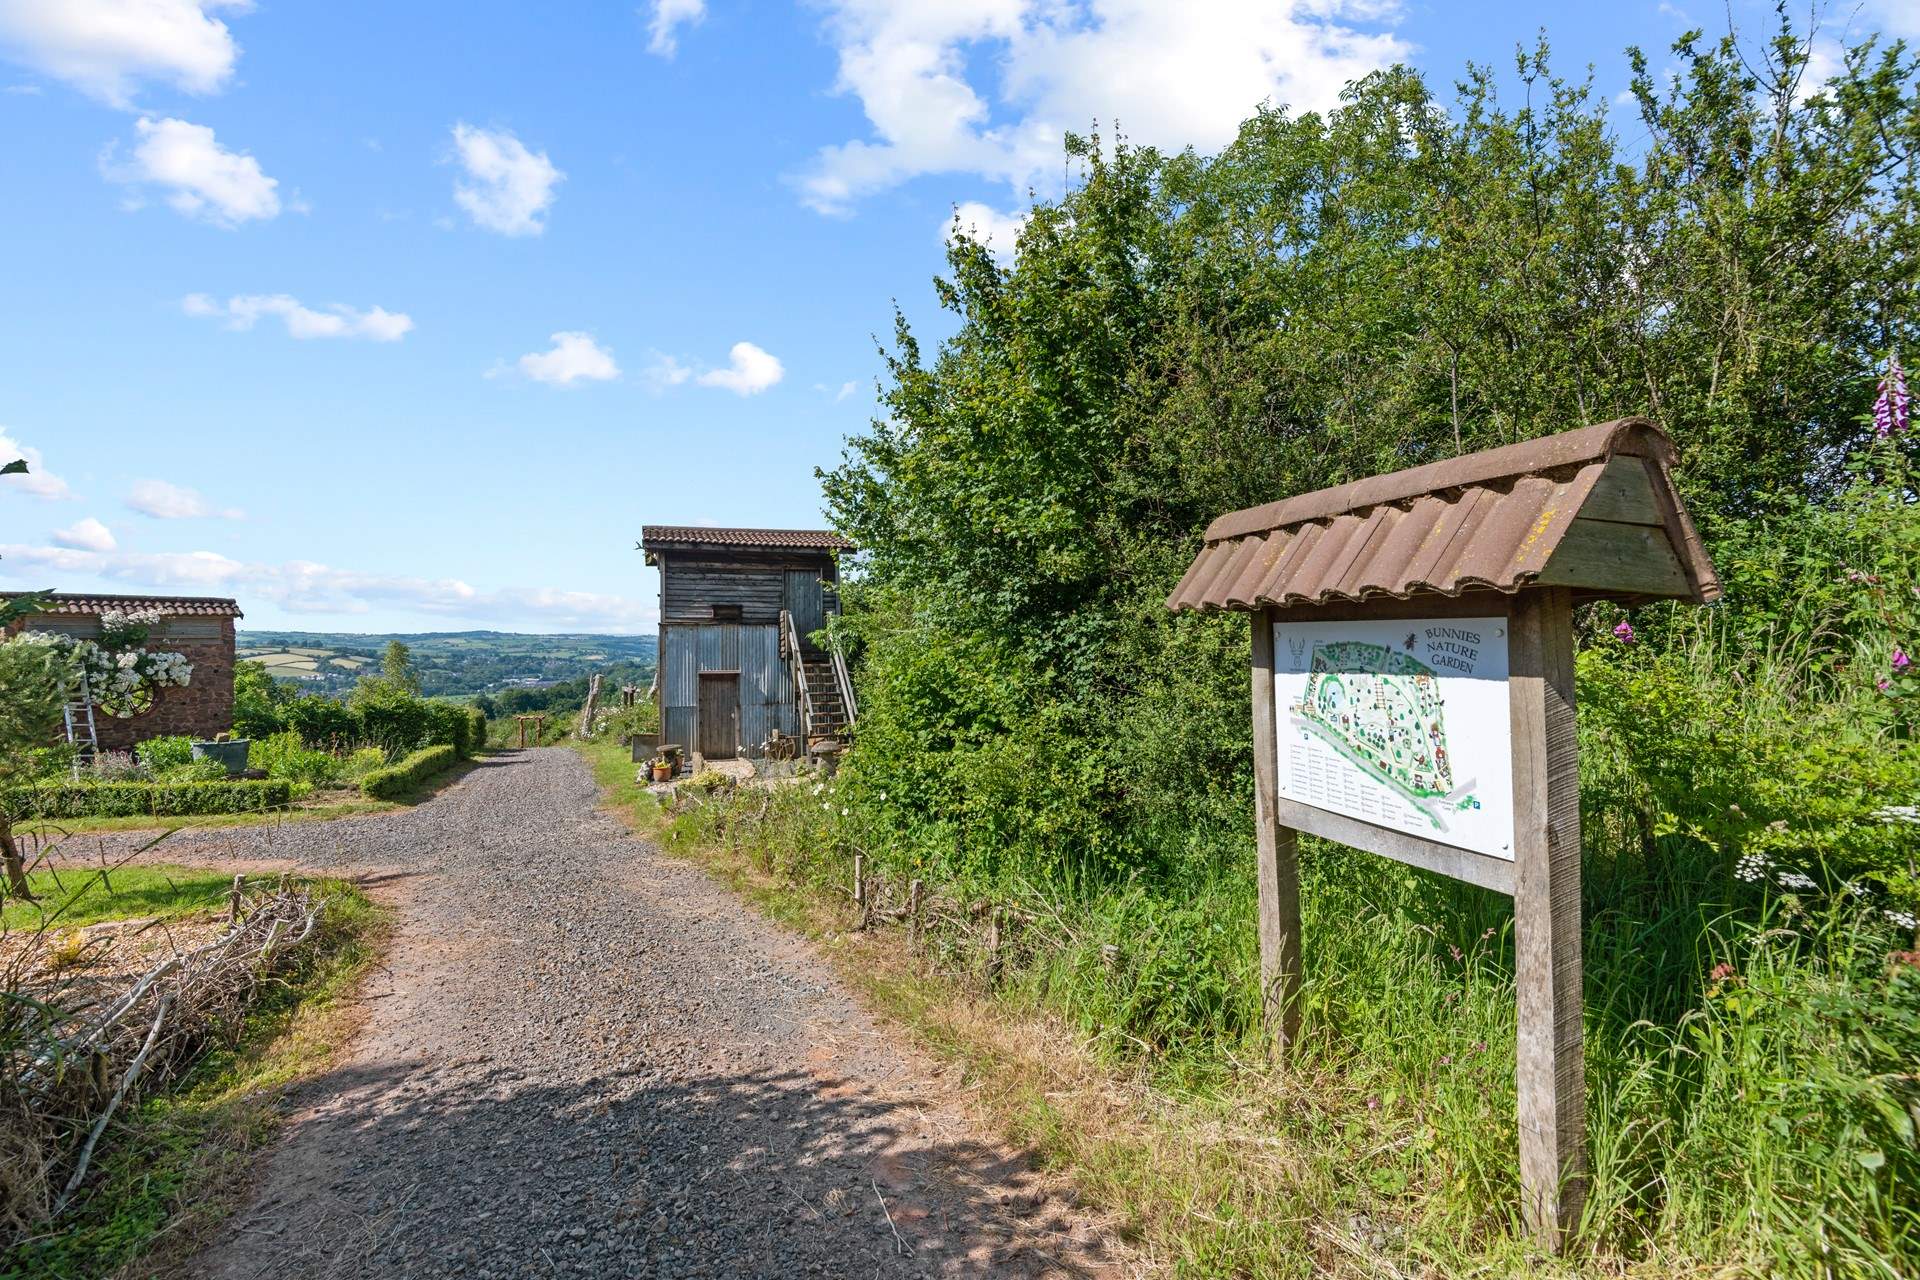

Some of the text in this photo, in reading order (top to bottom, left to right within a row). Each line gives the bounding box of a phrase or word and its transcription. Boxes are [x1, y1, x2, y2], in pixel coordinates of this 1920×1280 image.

[1425, 627, 1481, 645] BUNNIES
[1427, 641, 1479, 661] NATURE
[1431, 653, 1474, 675] GARDEN
